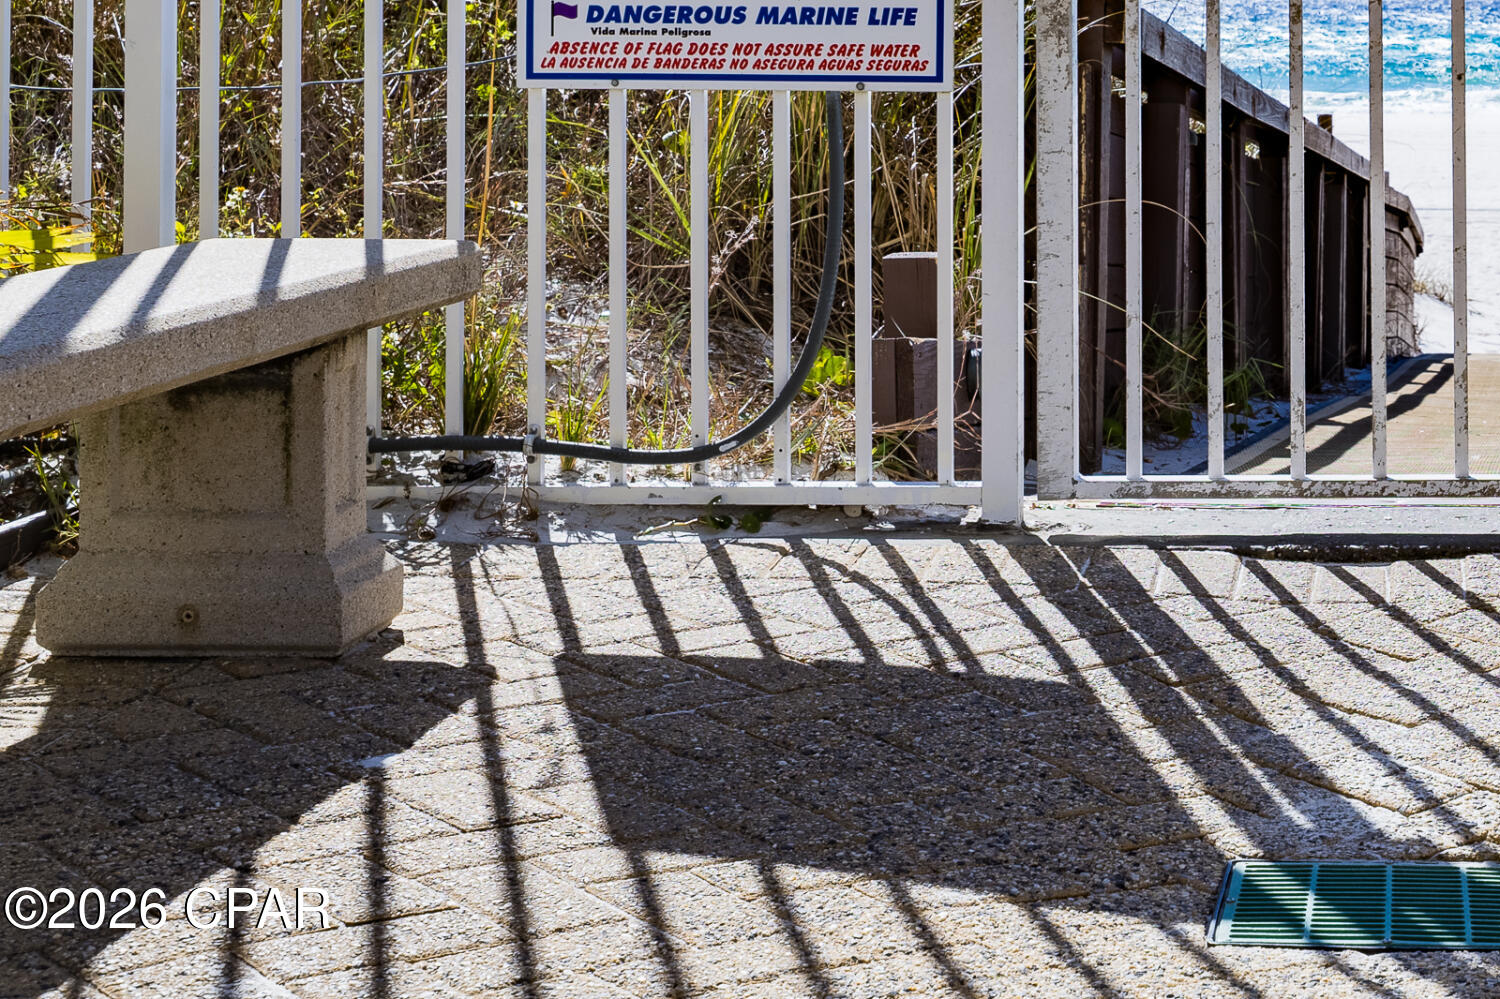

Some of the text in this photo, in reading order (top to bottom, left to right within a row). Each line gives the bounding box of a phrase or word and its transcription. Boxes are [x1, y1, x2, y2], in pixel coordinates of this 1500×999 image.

[586, 5, 918, 26] DANGEROUS MARINE LIFE
[591, 27, 711, 38] Vida Marina Peligrosa
[549, 41, 921, 58] ABSENCE OF FLAG DOES NOT ASSURE SAFE WATER
[540, 57, 929, 72] LA AUSENCIA DE BANDERAS NO ASEGURA AGUAS SEGURAS
